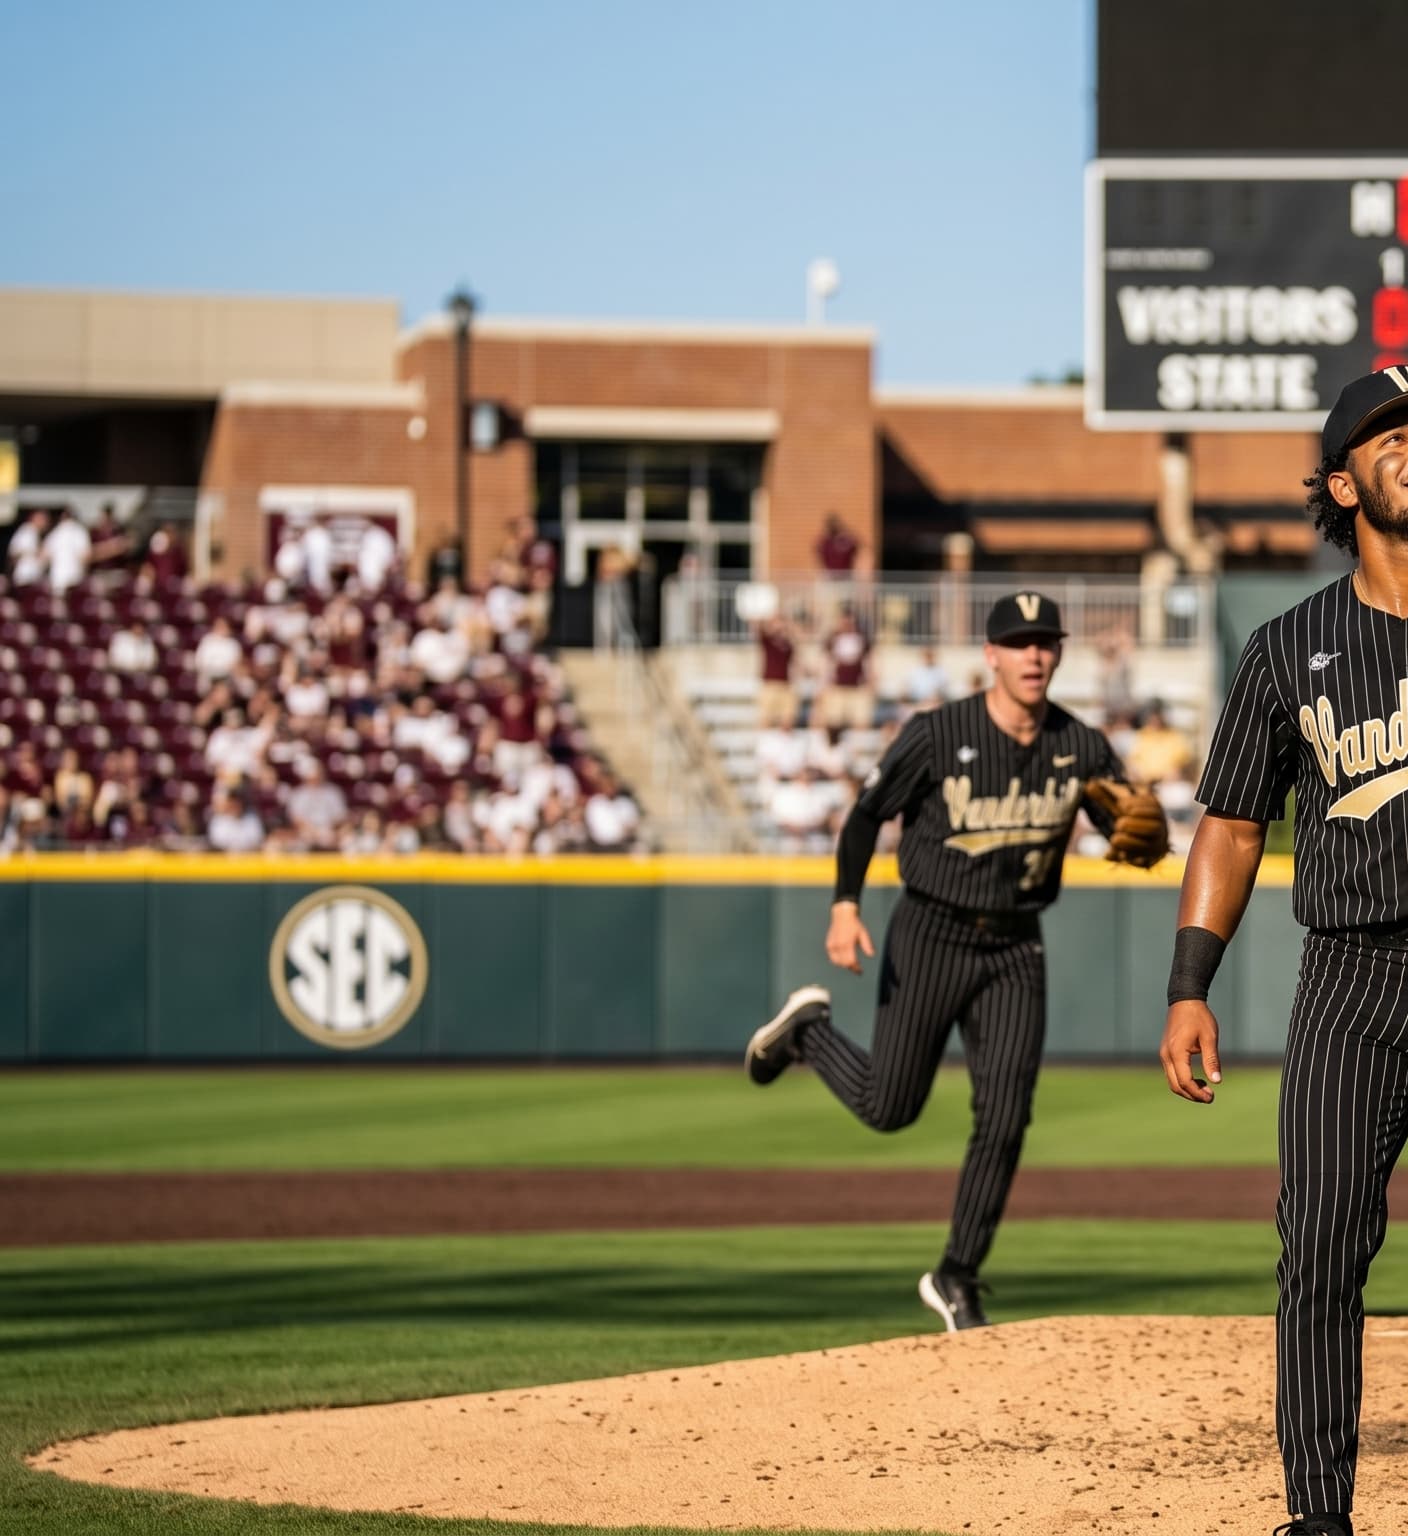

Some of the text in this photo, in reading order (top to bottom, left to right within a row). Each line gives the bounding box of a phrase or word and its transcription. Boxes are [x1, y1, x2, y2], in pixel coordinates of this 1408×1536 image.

[1117, 285, 1358, 345] VISITORS
[1157, 353, 1320, 411] STATE
[1016, 594, 1041, 621] V
[288, 899, 410, 1030] SEC
